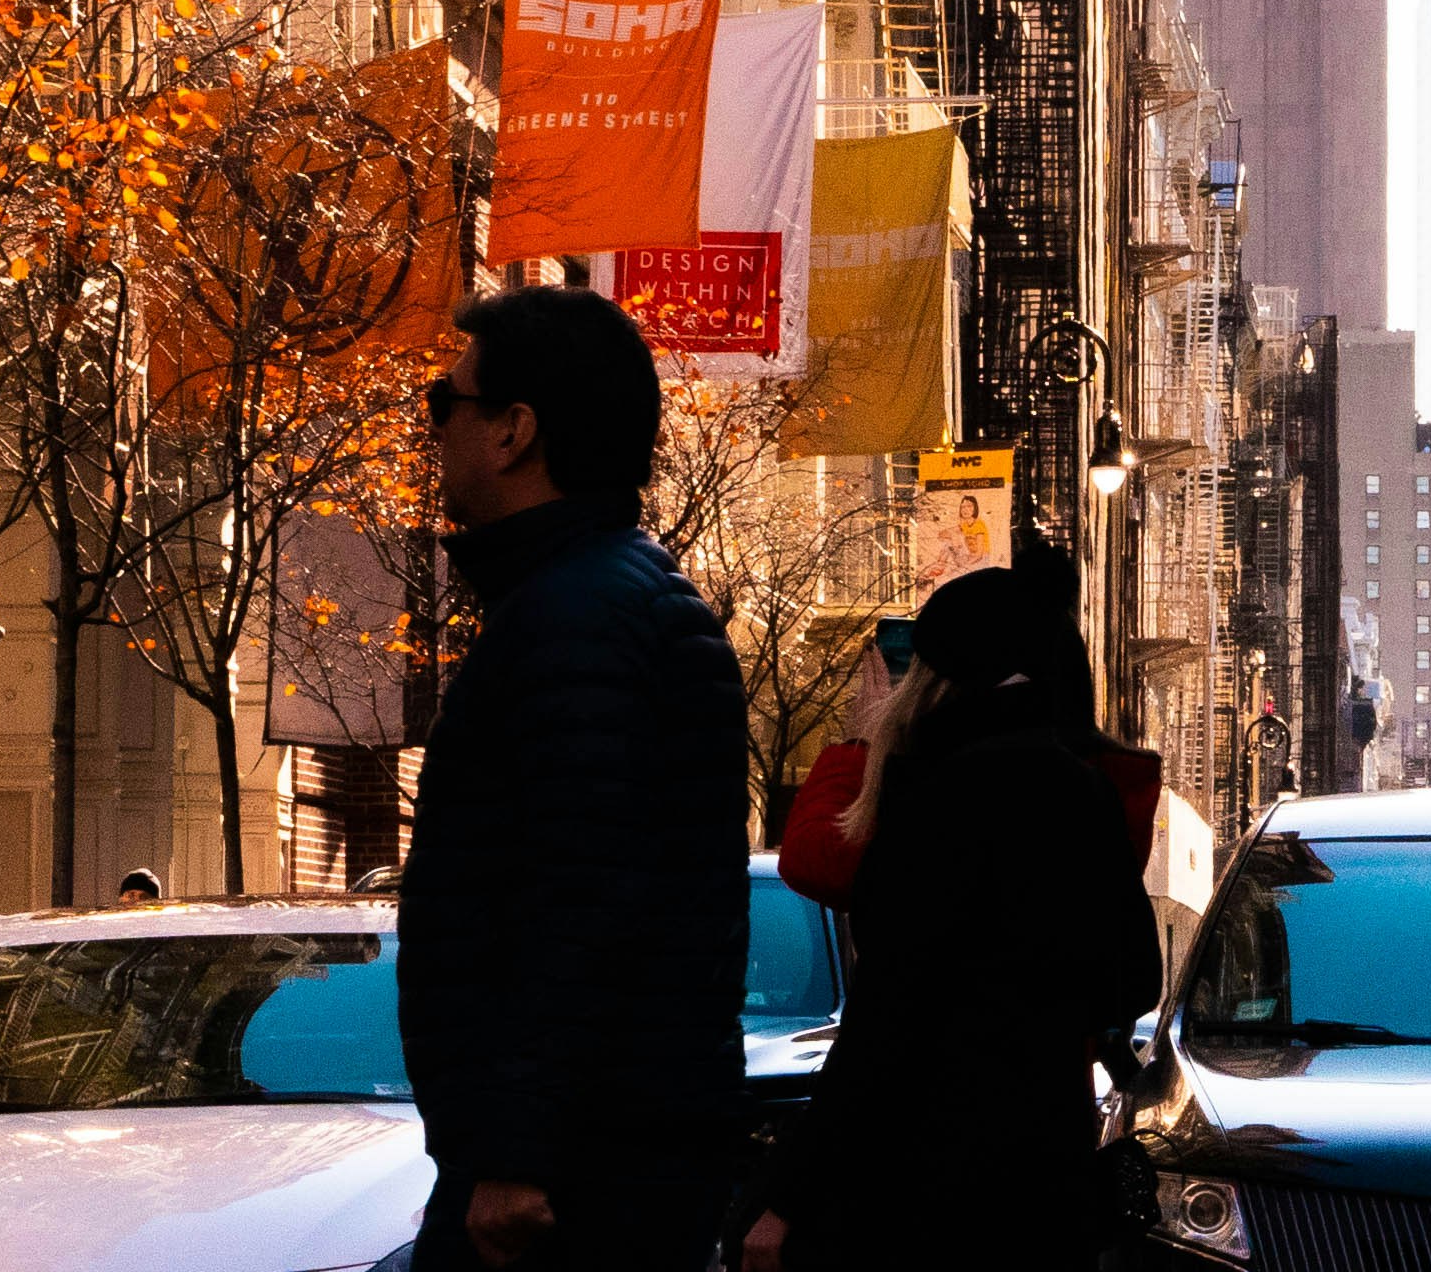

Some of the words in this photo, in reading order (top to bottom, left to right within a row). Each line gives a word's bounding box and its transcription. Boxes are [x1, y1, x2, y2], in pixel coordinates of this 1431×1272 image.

[546, 40, 670, 58] BUILDING
[580, 92, 619, 106] 110
[507, 112, 589, 134] GREENE
[603, 110, 689, 130] STREET
[639, 251, 754, 273] DESIGN
[638, 280, 752, 301] WITHIN
[636, 307, 751, 329] RACH
[951, 455, 982, 468] NYC
